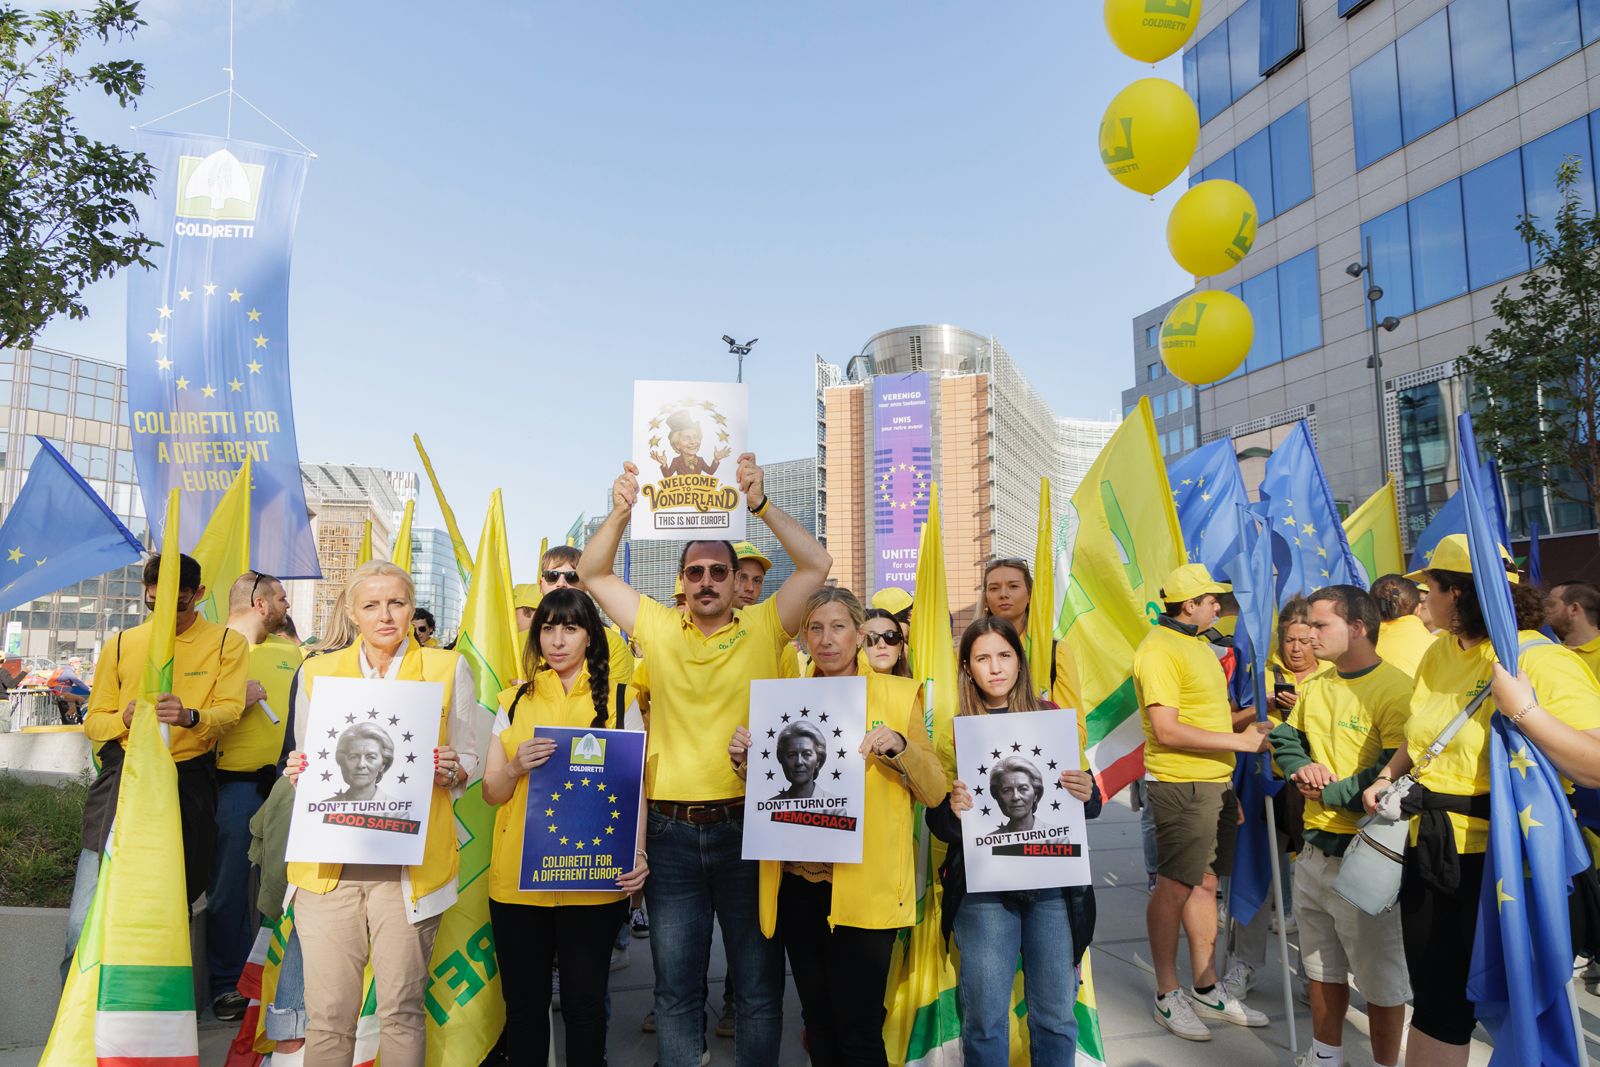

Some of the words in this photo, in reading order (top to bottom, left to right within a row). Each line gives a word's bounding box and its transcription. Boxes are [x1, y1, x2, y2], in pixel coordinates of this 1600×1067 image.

[1142, 18, 1187, 31] COLDIRETTI
[175, 222, 255, 238] COLDIRETTI
[882, 391, 921, 401] VERENIGD
[133, 411, 236, 434] COLDIRETTI
[244, 411, 280, 433] FOR
[892, 416, 912, 424] UNIS
[158, 442, 170, 463] A
[173, 440, 269, 464] DIFFERENT
[661, 476, 716, 489] WELCOME
[659, 516, 675, 526] THIS
[677, 516, 684, 526] IS
[686, 516, 699, 525] NOT
[700, 515, 726, 525] EUROPE
[882, 549, 918, 559] UNITE
[885, 572, 916, 581] FUTUR
[569, 765, 604, 773] COLDIRETTI
[308, 802, 348, 812] DON'T
[351, 802, 385, 811] TURN
[388, 801, 412, 811] OFF
[757, 801, 791, 811] DON'T
[793, 799, 824, 809] TURN
[826, 798, 847, 807] OFF
[328, 813, 365, 826] FOOD
[367, 817, 416, 833] SAFETY
[774, 811, 855, 829] DEMOCRACY
[975, 834, 1012, 846] DON'T
[1014, 830, 1046, 842] TURN
[1048, 826, 1069, 838] OFF
[1023, 844, 1072, 855] HEALTH
[542, 855, 592, 868] COLDIRETTI
[595, 854, 612, 867] FOR
[532, 870, 539, 882] A
[541, 868, 588, 882] DIFFERENT
[589, 867, 623, 880] EUROPE
